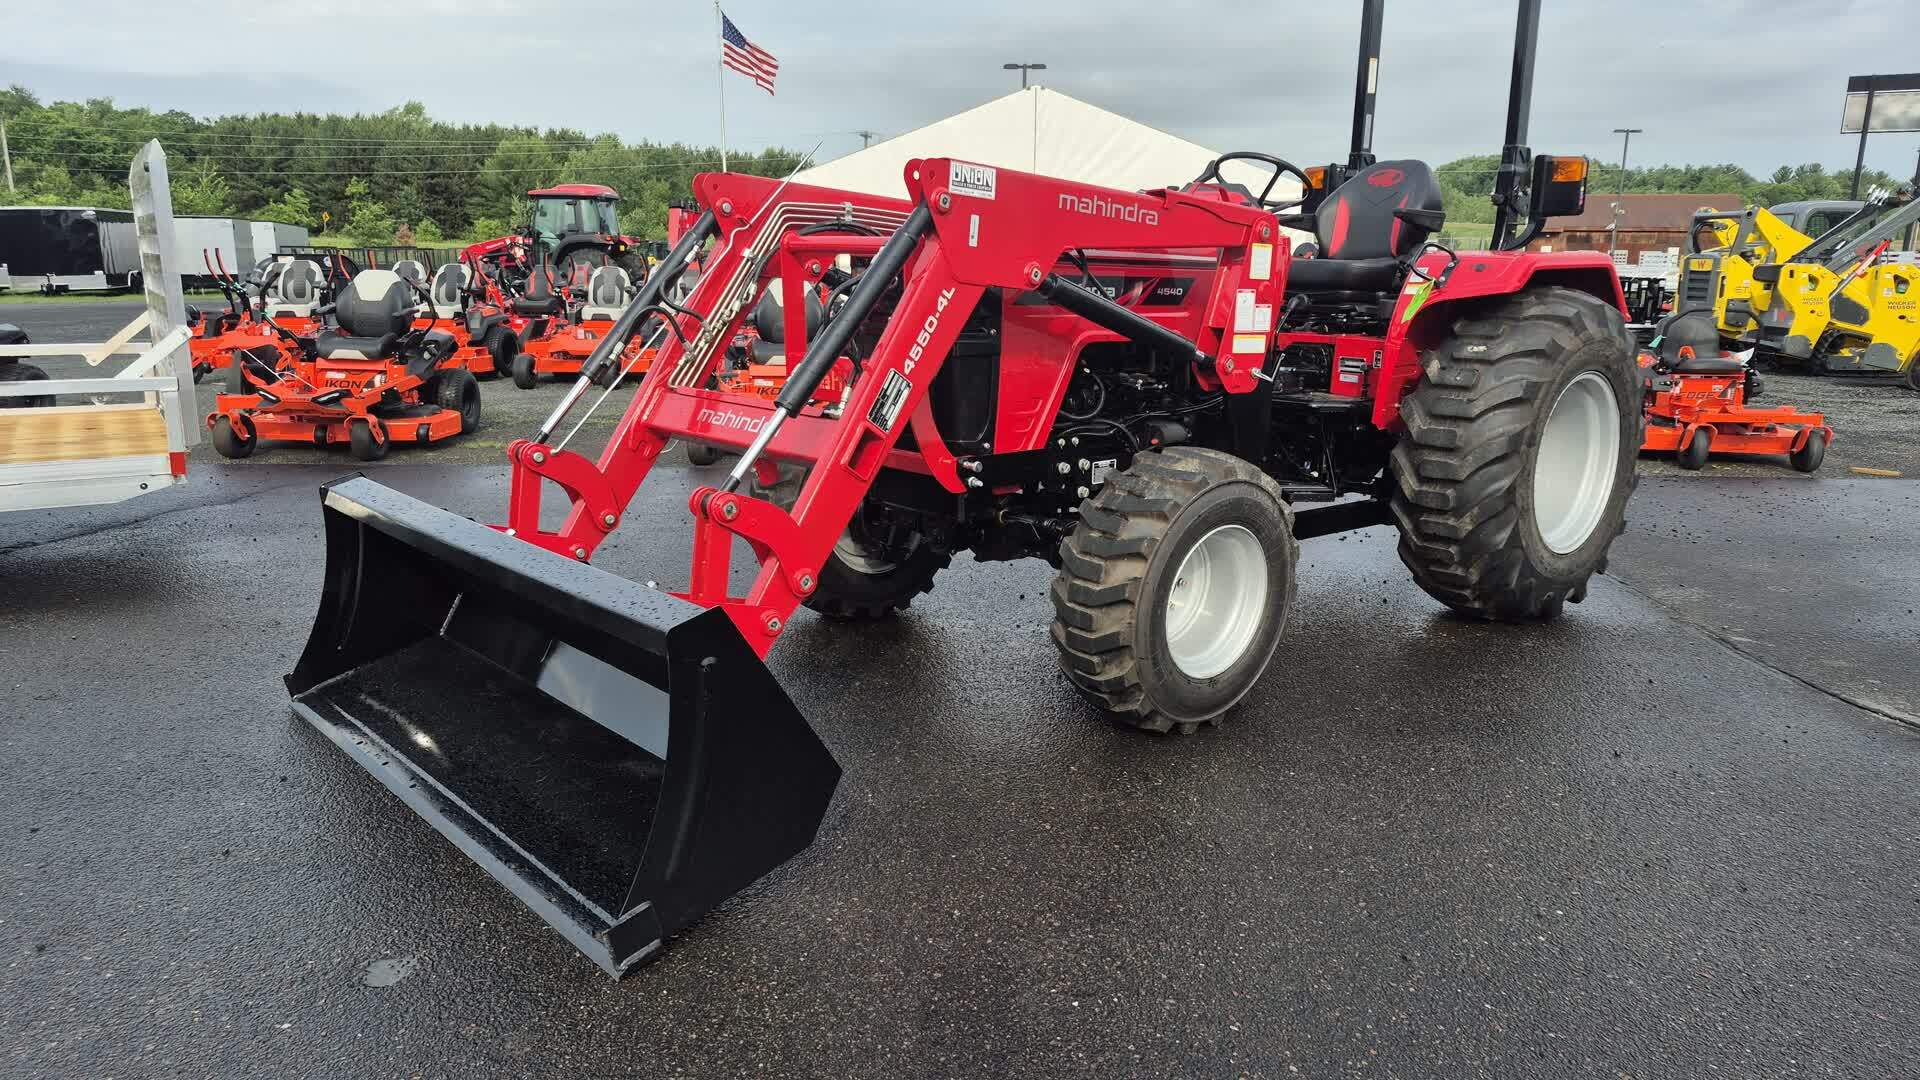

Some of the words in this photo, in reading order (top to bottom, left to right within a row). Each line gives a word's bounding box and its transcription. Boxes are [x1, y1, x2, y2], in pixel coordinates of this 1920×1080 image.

[952, 163, 993, 188] UNION
[1058, 194, 1159, 226] mahindra
[1156, 287, 1184, 296] 4540
[325, 379, 362, 389] IKON
[756, 387, 781, 396] IKO
